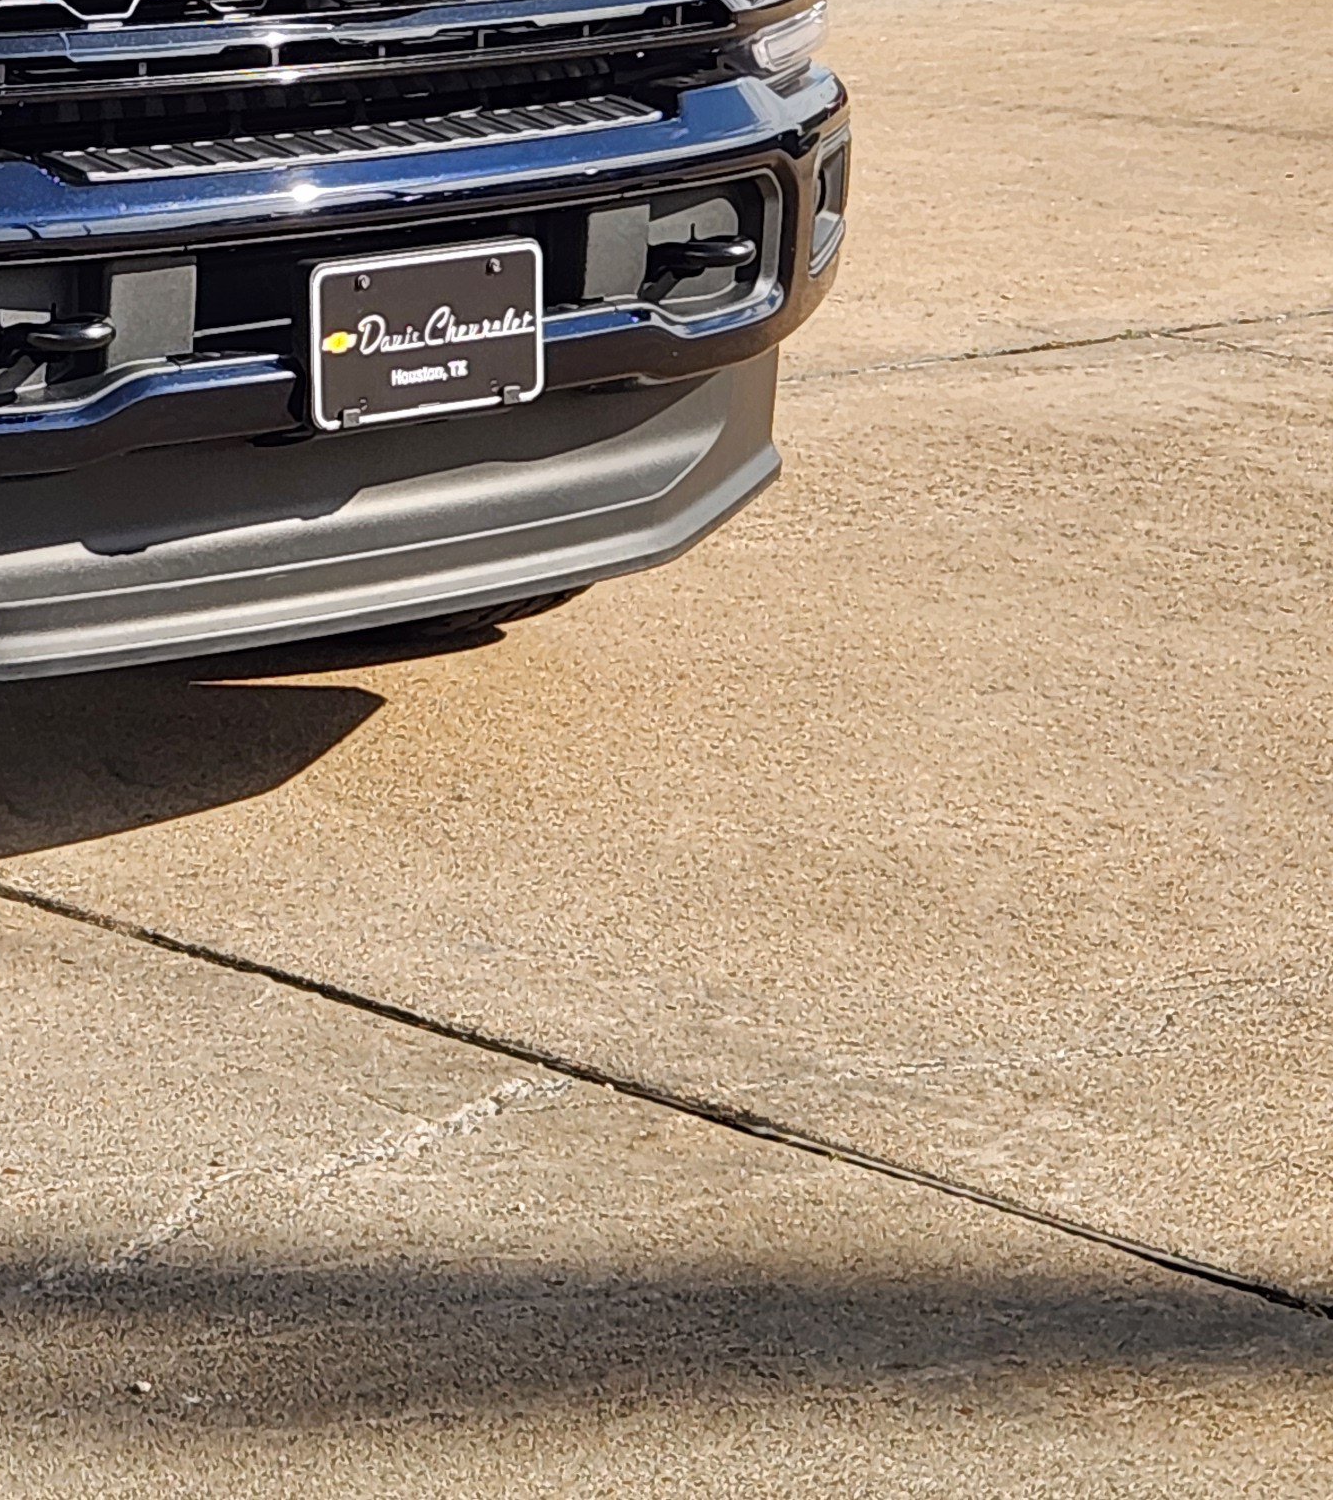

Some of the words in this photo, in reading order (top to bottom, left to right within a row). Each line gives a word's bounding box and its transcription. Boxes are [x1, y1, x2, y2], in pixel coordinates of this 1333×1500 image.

[358, 314, 425, 355] Davis
[424, 305, 536, 346] Chevrolet
[391, 365, 448, 387] Houston,
[447, 359, 469, 378] TX
